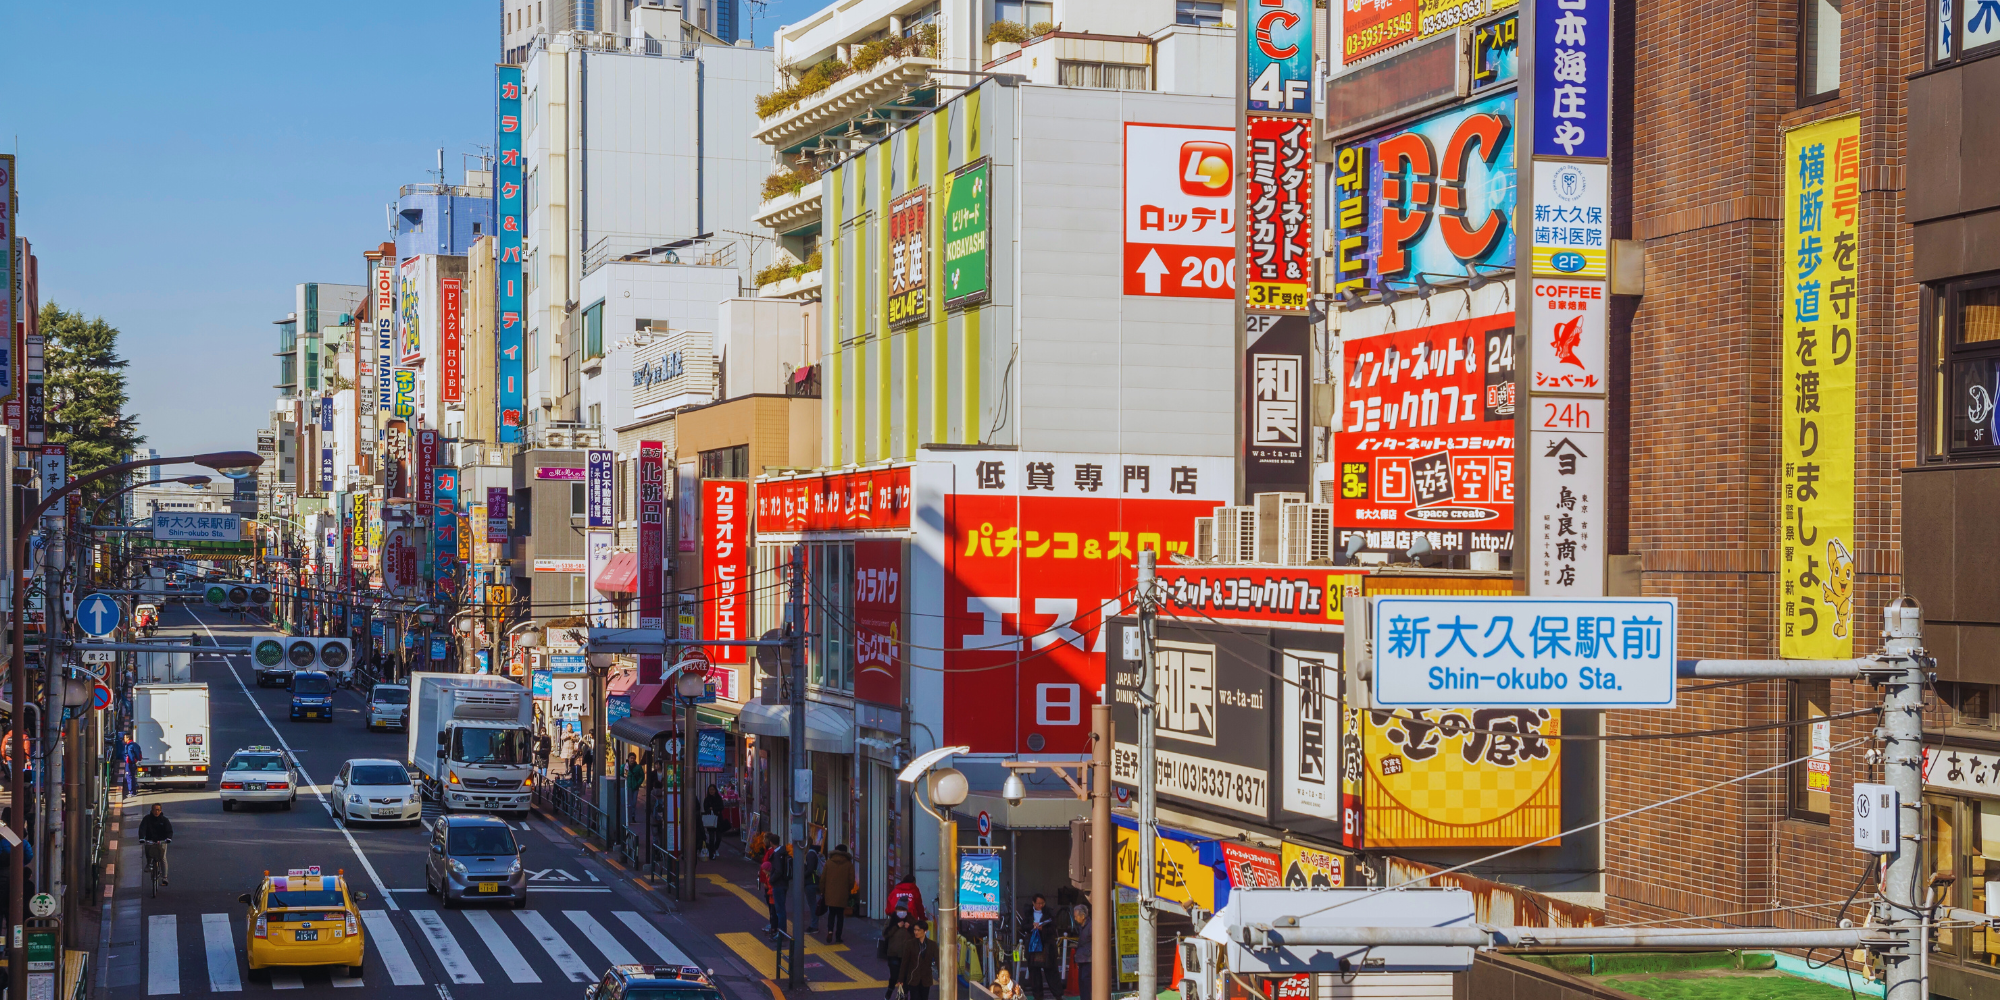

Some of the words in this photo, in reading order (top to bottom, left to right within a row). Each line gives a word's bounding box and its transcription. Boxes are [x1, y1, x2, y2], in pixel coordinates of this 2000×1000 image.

[1256, 0, 1301, 60] C
[1346, 11, 1412, 56] 03-5937-5548
[1491, 18, 1516, 49] 入口
[1250, 62, 1309, 110] 4F
[1252, 140, 1278, 279] コミックカフェ
[1281, 124, 1304, 280] インターネット&
[1377, 113, 1510, 276] PC
[952, 203, 980, 232] ビリヤード
[1535, 204, 1602, 224] 新大久保
[947, 231, 985, 262] KOBAYASHI
[1535, 226, 1602, 247] 歯科医院
[1829, 135, 1859, 366] 信号を守り
[501, 82, 521, 428] カラオケ&パーティー館
[892, 232, 923, 292] 英雄
[1559, 255, 1579, 269] 2F
[379, 270, 390, 311] HOTEL
[1535, 285, 1602, 300] COFFEE
[1548, 300, 1587, 311] 自家焙煎
[447, 292, 456, 340] PLAZA
[1247, 318, 1270, 333] 2F
[379, 318, 390, 350] SUN
[1350, 334, 1478, 387] インターネット&
[1487, 333, 1515, 374] 24
[379, 355, 390, 412] MARINE
[447, 349, 456, 397] HOTEL
[1536, 373, 1600, 388] シュベール
[1257, 359, 1297, 443] 和民
[1795, 143, 1825, 637] 横断歩道を渡りましょう
[1348, 385, 1478, 432] コミックカフェ
[1544, 402, 1590, 429] 24h
[1974, 429, 1985, 441] 3F
[642, 448, 661, 458] 漢方
[1252, 450, 1302, 459] wa-ta-mi
[1343, 464, 1367, 473] 当ビル
[323, 458, 333, 482] 公営社
[976, 460, 1198, 495] 低貸専門店
[1343, 473, 1367, 498] 3F
[641, 461, 661, 524] 化粧品
[157, 516, 236, 530] 新大久保駅前
[716, 486, 734, 558] カラオケ
[1356, 508, 1397, 520] 新大久保店
[1417, 509, 1449, 518] space
[1450, 509, 1486, 518] create
[168, 529, 209, 537] Shin-okubo
[1785, 462, 1795, 637] 新宿警察署・新宿区
[857, 567, 899, 604] カラオケ
[717, 565, 737, 659] ビッグエコー
[857, 630, 898, 667] ビッグエコー
[1388, 615, 1663, 660] 新大久保駅前
[1155, 650, 1213, 736] 和民
[1428, 666, 1568, 690] Shin-okubo
[1579, 667, 1622, 690] Sta.
[553, 702, 587, 713] ルノアール
[1219, 689, 1264, 710] wa-ta-mi
[1301, 665, 1325, 778] 和民
[1297, 787, 1327, 800] wa-ta-mi
[1808, 771, 1830, 791] 営業中
[1344, 807, 1360, 837] B1
[962, 860, 992, 877] 分煙で
[1301, 850, 1330, 870] きんくら酒場
[961, 871, 999, 888] 思いやりの
[961, 881, 983, 895] 街に。
[300, 933, 318, 941] 15-14
